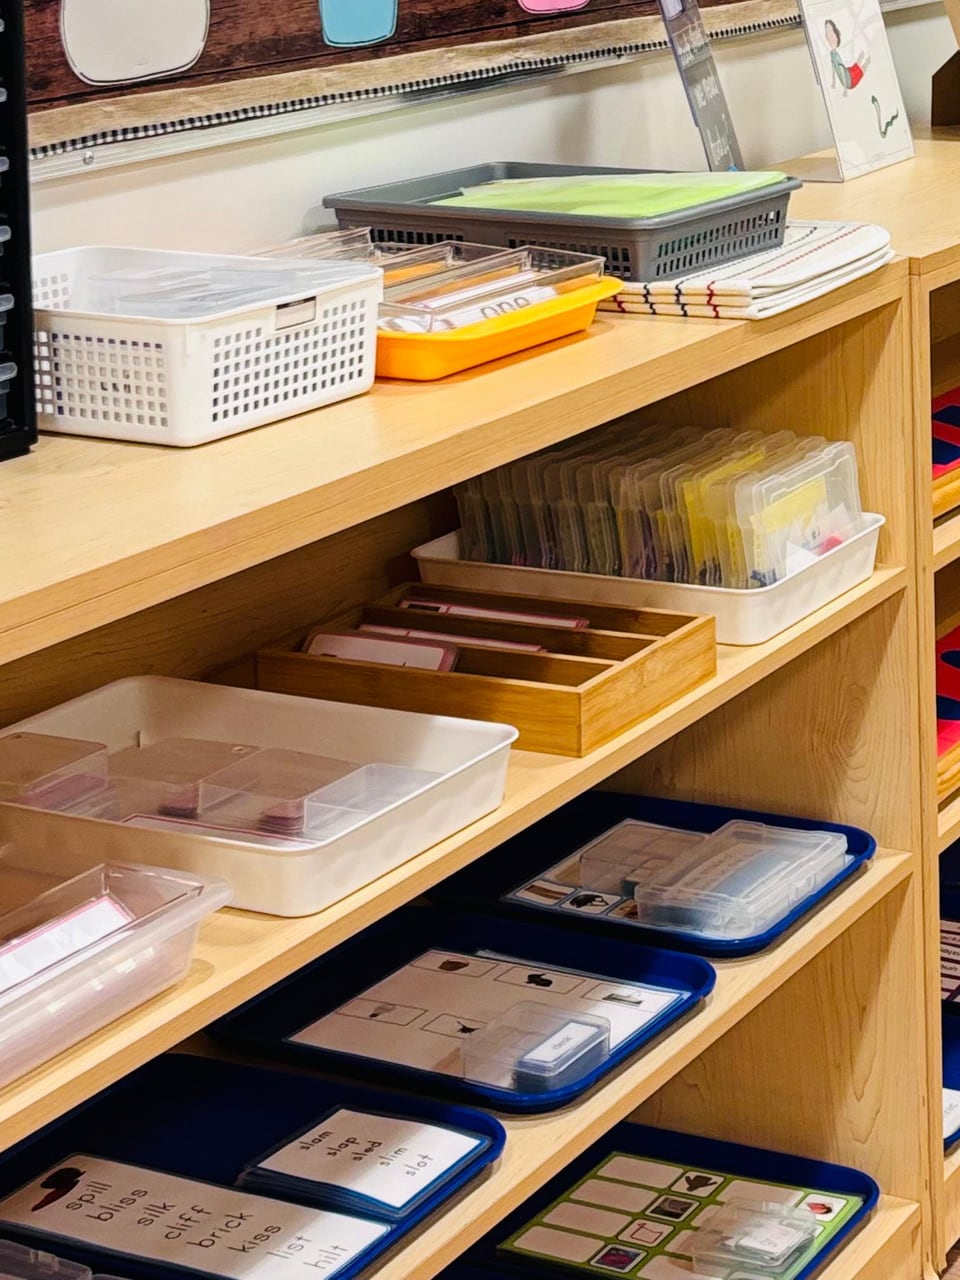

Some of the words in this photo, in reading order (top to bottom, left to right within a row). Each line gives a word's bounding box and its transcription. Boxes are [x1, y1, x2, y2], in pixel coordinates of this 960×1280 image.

[300, 1131, 333, 1150] slam
[326, 1137, 360, 1157] slap
[353, 1140, 382, 1161] sled
[379, 1147, 408, 1166] slim
[404, 1154, 434, 1176] slot
[65, 1180, 112, 1211] spill
[86, 1189, 148, 1221] bliss
[137, 1202, 176, 1226] silk
[164, 1205, 212, 1240] cliff
[186, 1212, 253, 1248] brick
[228, 1225, 282, 1253] kiss
[266, 1235, 312, 1259] list
[303, 1245, 348, 1269] hilt
